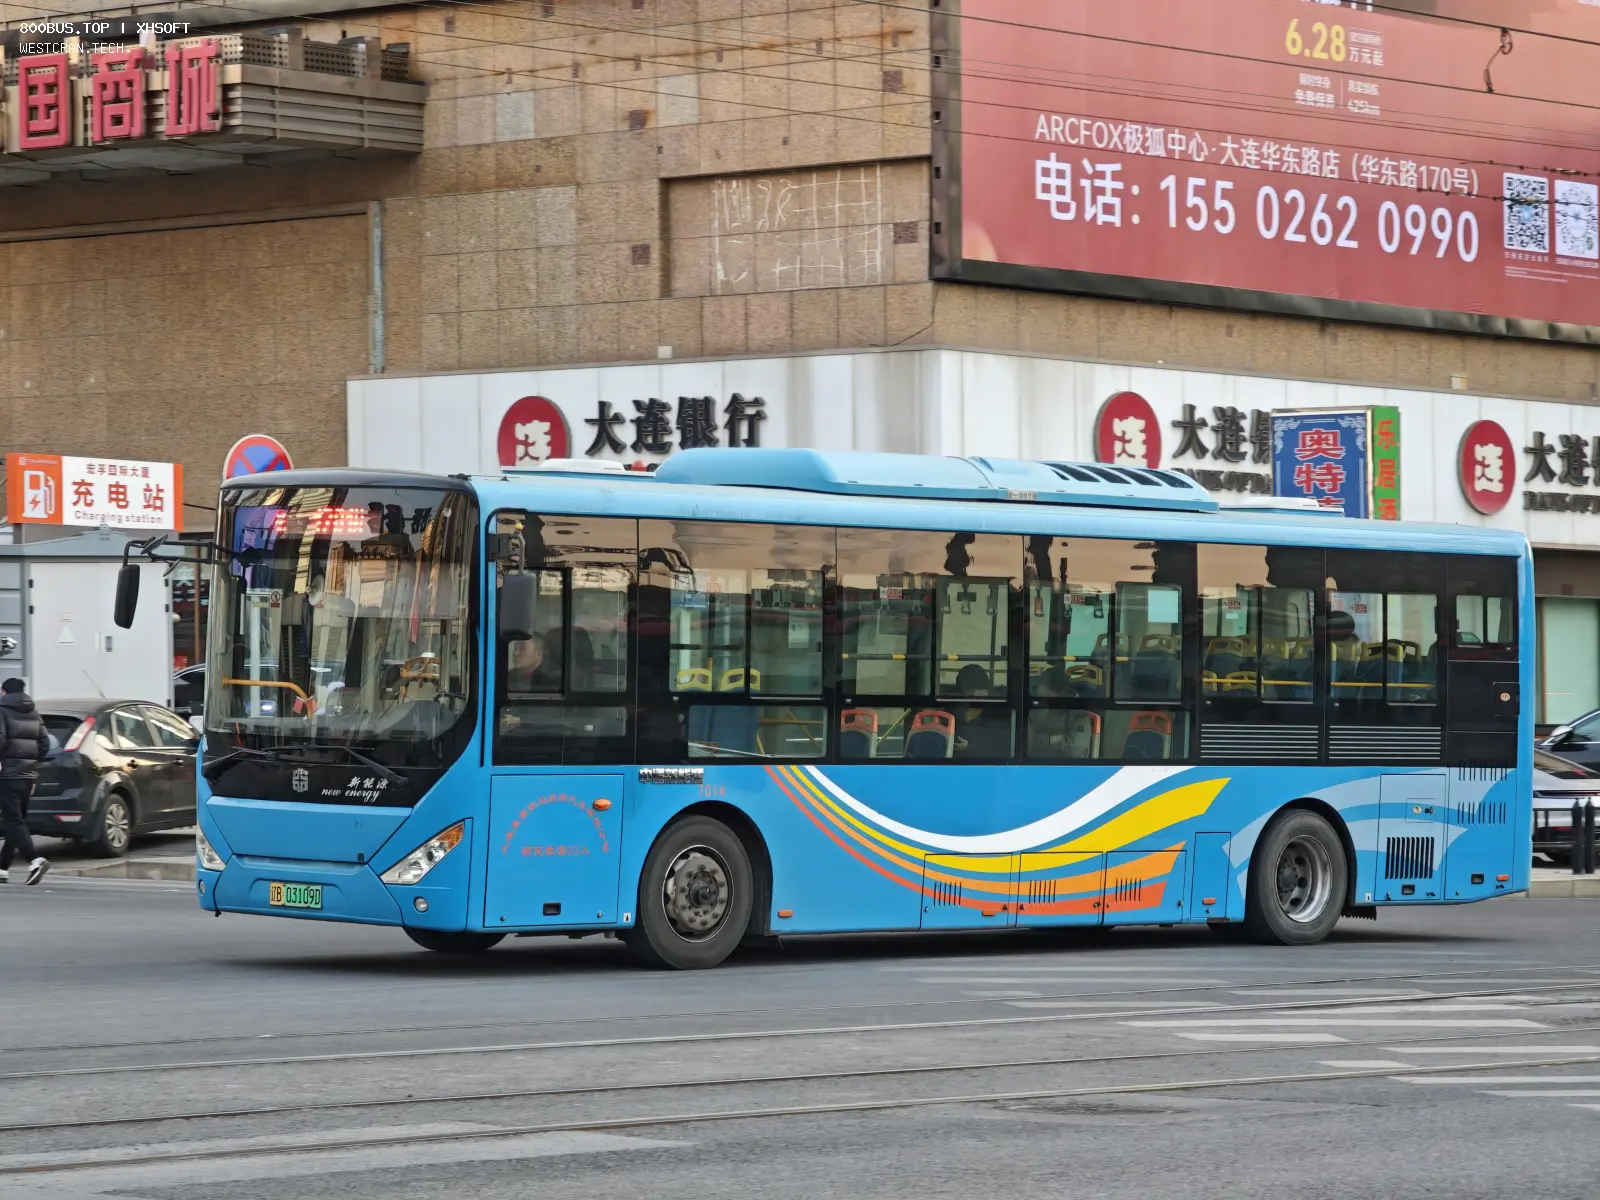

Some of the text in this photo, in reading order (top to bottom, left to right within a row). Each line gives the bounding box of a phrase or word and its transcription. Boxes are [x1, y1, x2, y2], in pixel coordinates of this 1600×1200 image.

[1286, 19, 1346, 62] 6.28
[1349, 46, 1384, 66] 万元起
[1159, 174, 1236, 235] 155
[1256, 185, 1359, 249] 0262
[1378, 200, 1480, 263] 0990
[71, 479, 166, 512] 充电站
[74, 510, 163, 525] Charging station
[347, 776, 389, 790] 新能源
[697, 784, 726, 797] 7014
[321, 788, 382, 803] new energy
[286, 886, 321, 905] 03109D
